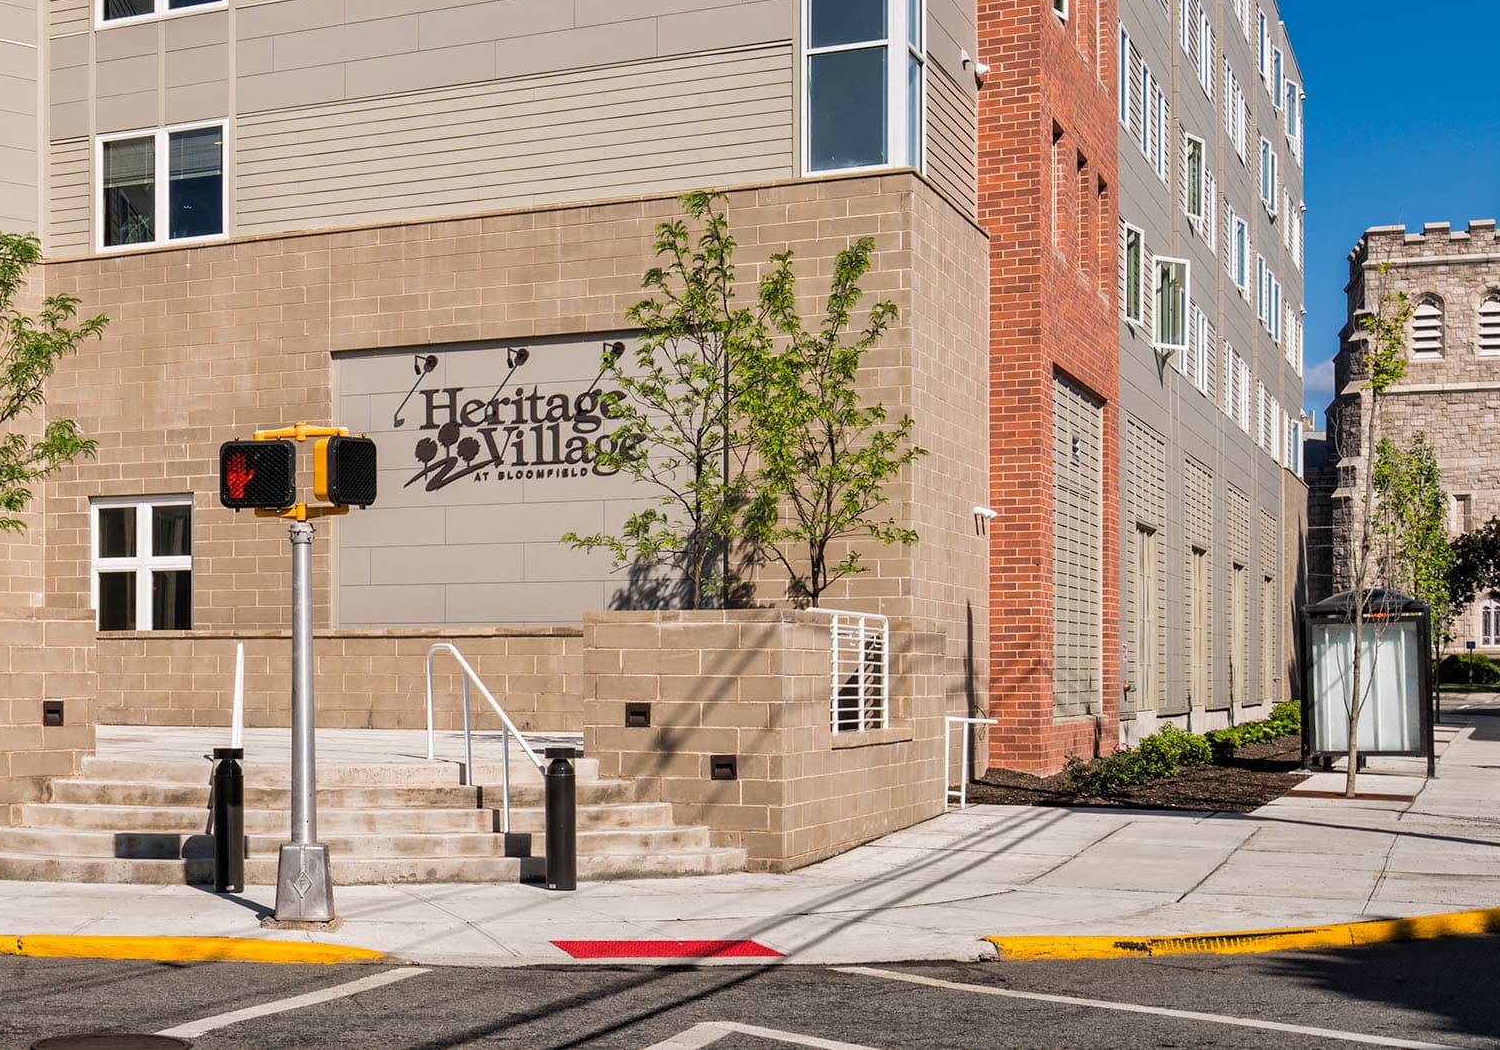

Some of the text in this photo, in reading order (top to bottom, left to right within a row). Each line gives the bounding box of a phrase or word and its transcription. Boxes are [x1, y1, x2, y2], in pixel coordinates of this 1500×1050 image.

[419, 384, 627, 434] Heritage
[474, 467, 588, 482] AT BLOOMFIELD
[476, 423, 646, 476] Village
